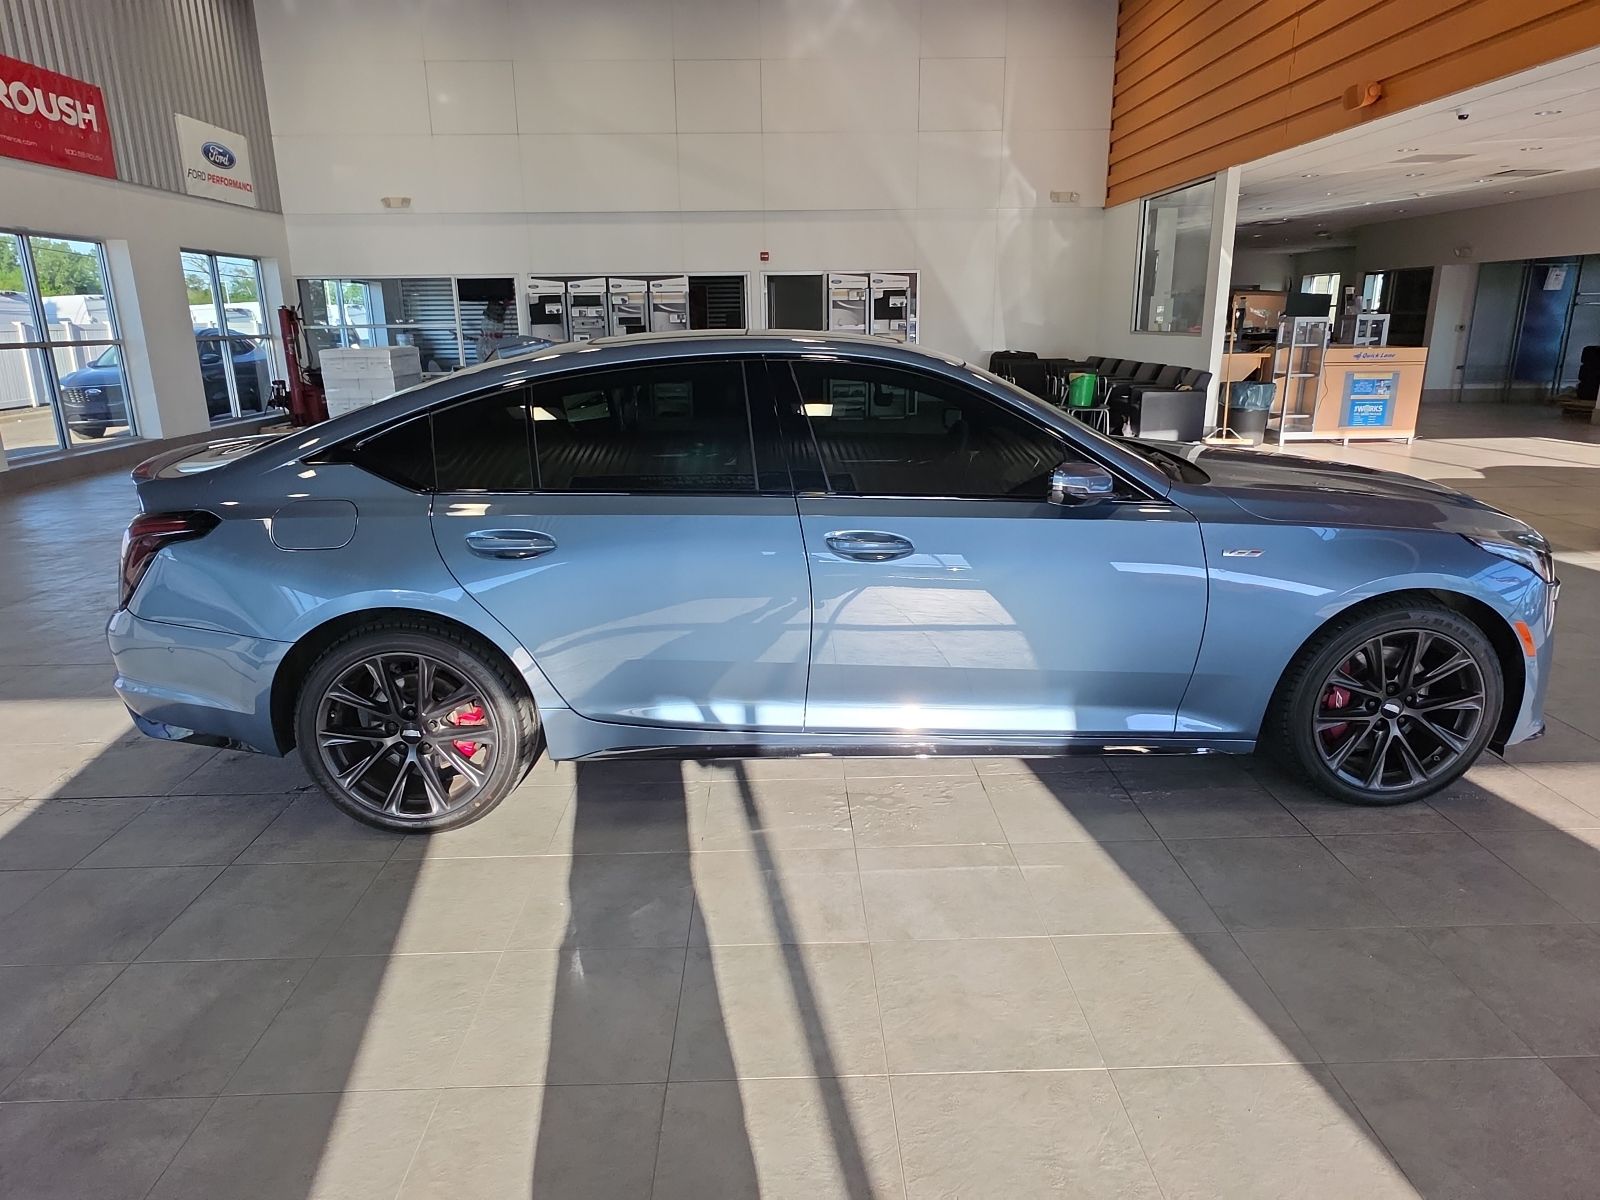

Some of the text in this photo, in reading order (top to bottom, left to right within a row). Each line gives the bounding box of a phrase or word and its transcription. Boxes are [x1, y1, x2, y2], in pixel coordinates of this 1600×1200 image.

[0, 78, 98, 132] ROUSH
[208, 145, 230, 166] Ford
[187, 168, 206, 181] FORD
